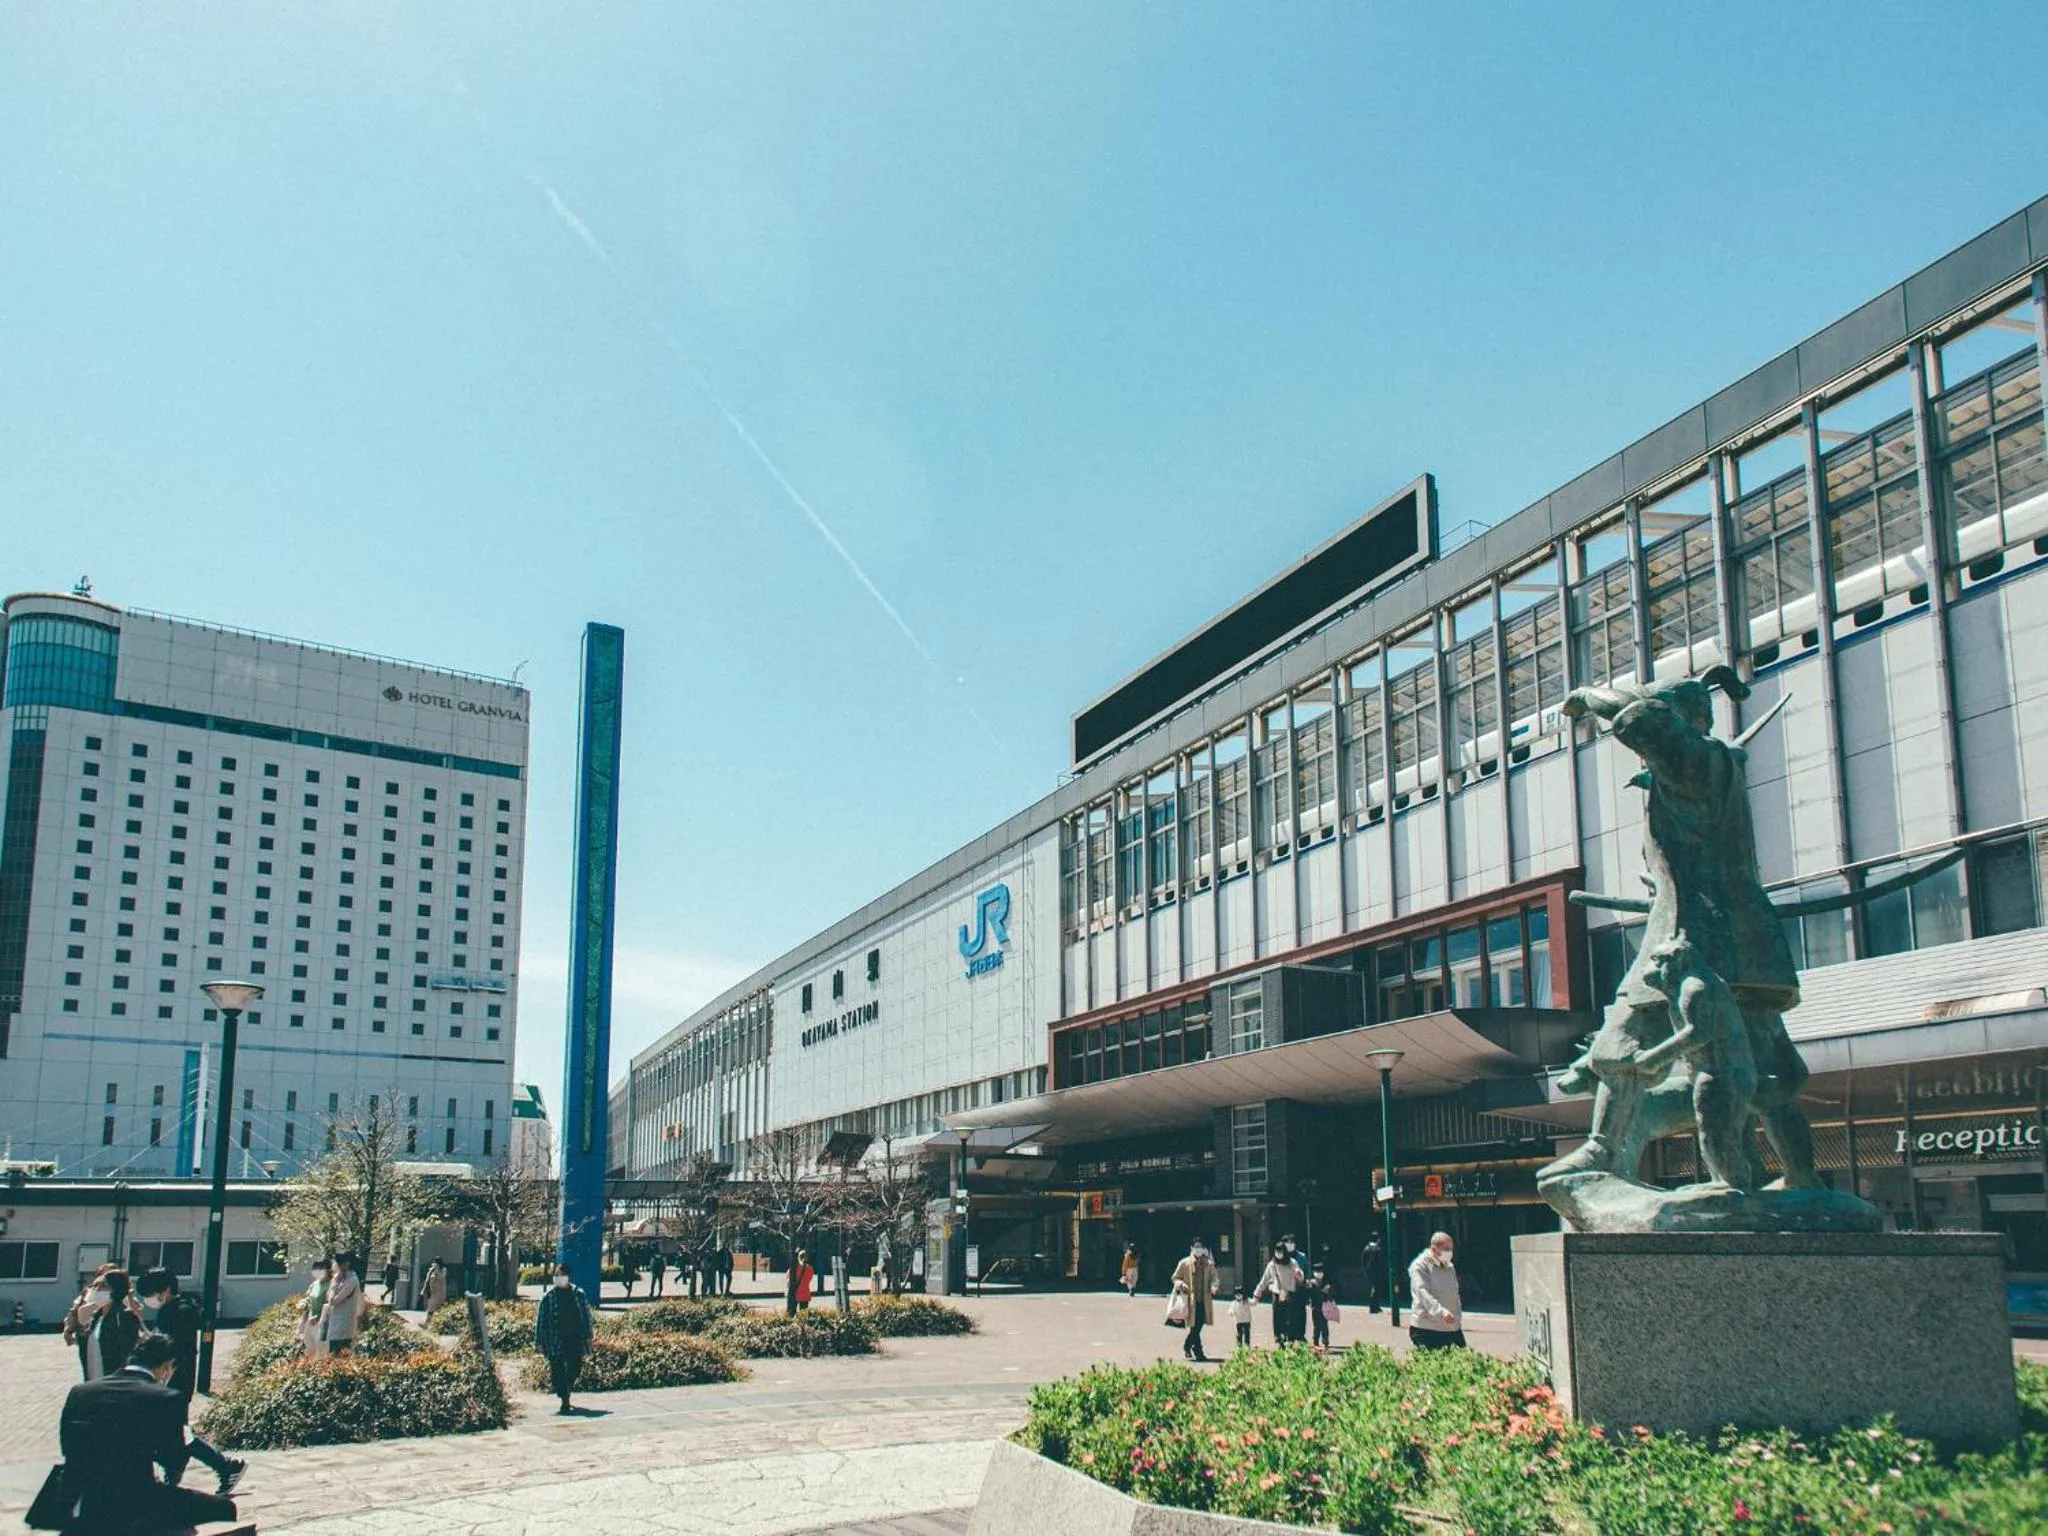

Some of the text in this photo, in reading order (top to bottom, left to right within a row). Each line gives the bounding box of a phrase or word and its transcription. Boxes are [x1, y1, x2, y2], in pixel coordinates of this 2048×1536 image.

[408, 691, 522, 722] HOTEL GRANVIA
[959, 884, 1010, 957] JR
[802, 1000, 879, 1047] OKAYAMA STATION
